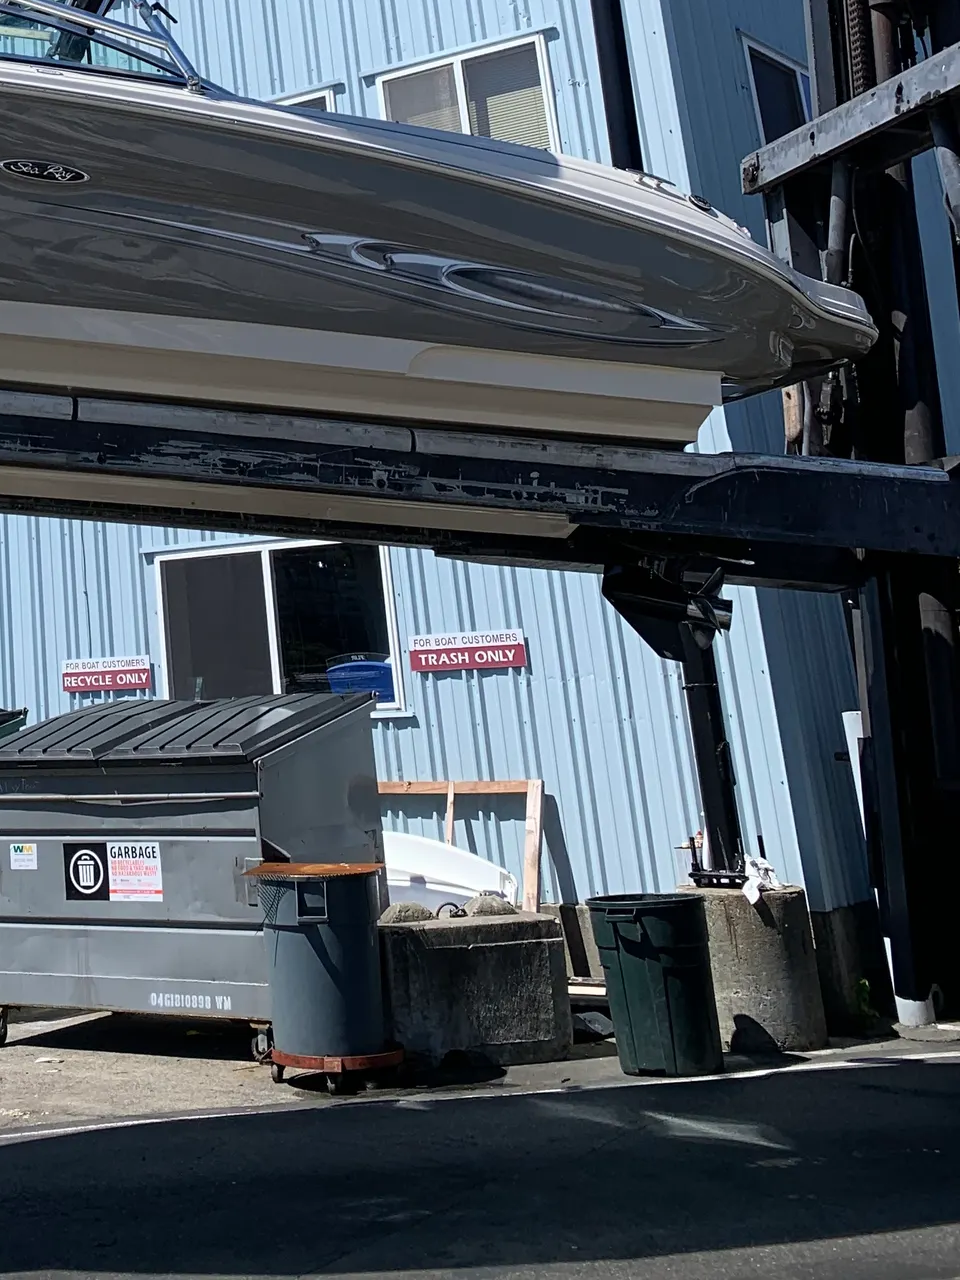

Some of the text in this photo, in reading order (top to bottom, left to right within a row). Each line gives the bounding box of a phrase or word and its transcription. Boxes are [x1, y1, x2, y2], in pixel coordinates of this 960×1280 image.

[10, 162, 75, 181] Sea Ray
[413, 632, 518, 647] FOR BOAT CUSTOMERS
[65, 658, 146, 670] FOR BOAT CUSTOMERS
[418, 649, 516, 666] TRASH ONLY
[63, 672, 148, 687] RECYCLE ONLY
[13, 845, 33, 853] WM
[110, 846, 157, 859] GARBAGE
[215, 995, 232, 1010] WM
